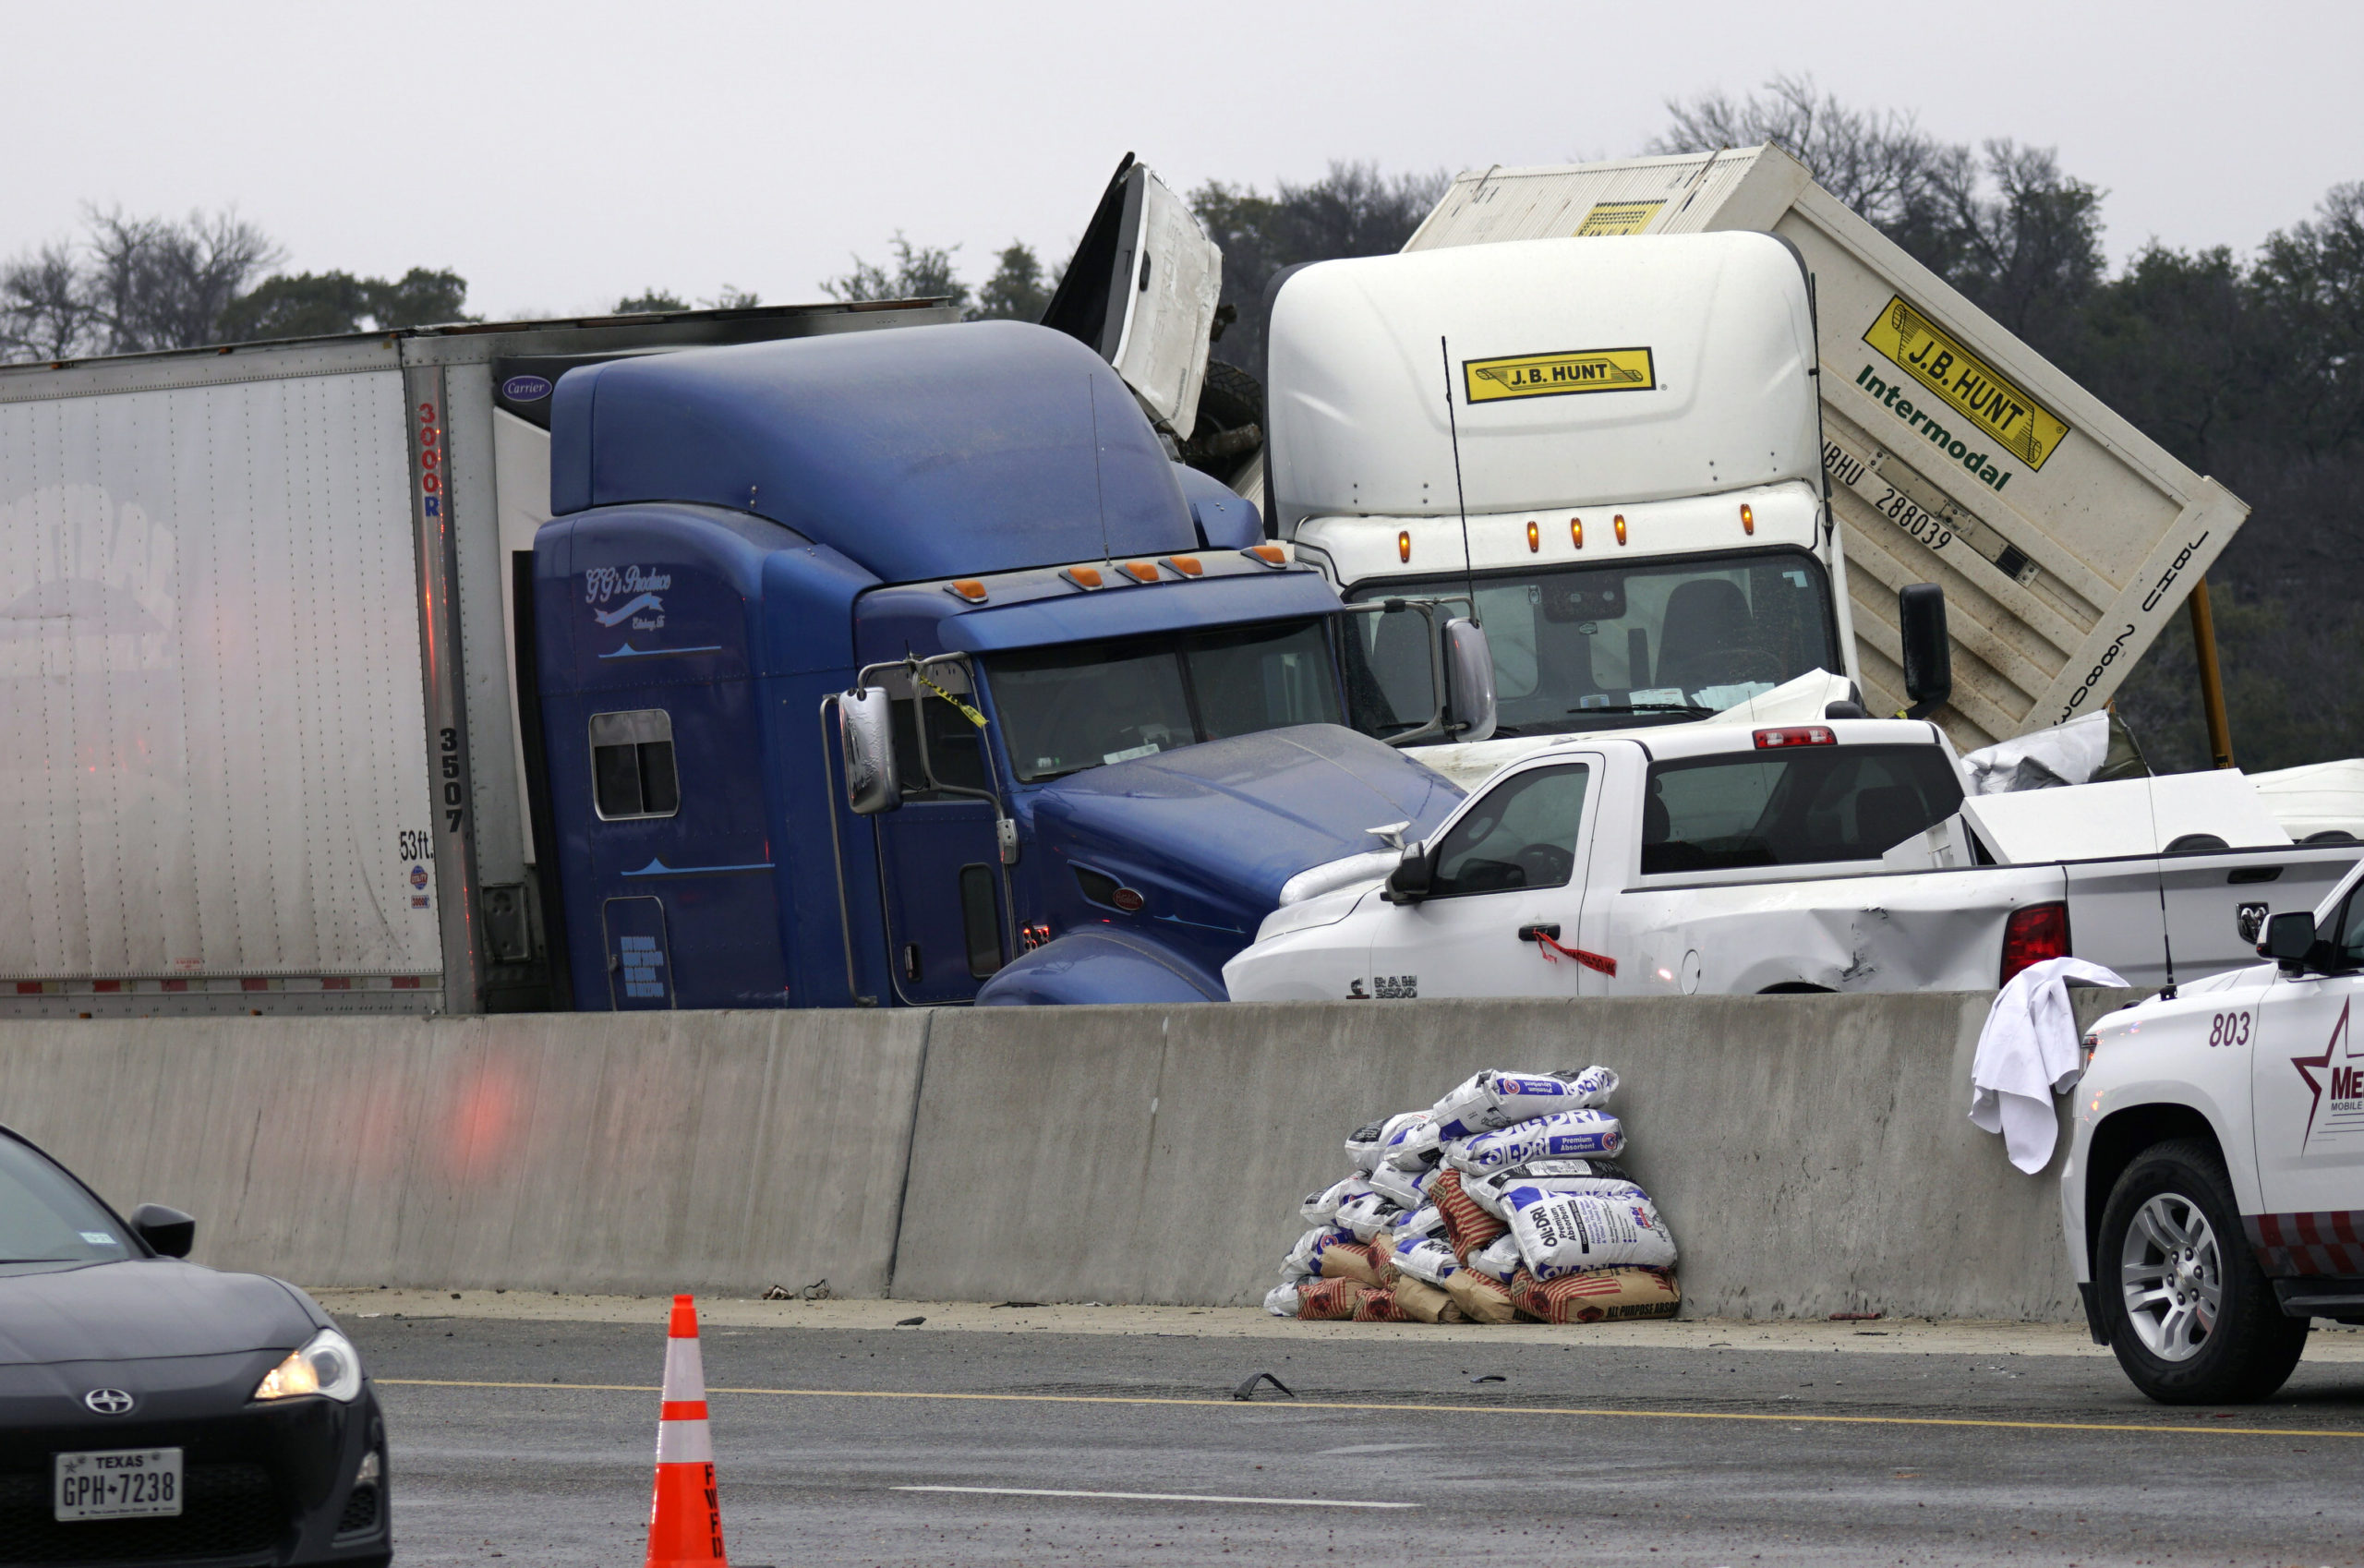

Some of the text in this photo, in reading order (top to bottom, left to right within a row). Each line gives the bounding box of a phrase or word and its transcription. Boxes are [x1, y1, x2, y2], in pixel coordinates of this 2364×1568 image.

[507, 381, 546, 395] Carrier
[1511, 364, 1608, 386] J.B. HUNT
[1908, 341, 2026, 432] J.B. HUNT
[1855, 364, 2013, 492] Intermodal
[418, 403, 440, 517] 3000R
[1875, 488, 1953, 550] 288039
[2141, 530, 2210, 612] JBHU
[440, 728, 463, 833] 3507
[400, 830, 435, 861] 53ft.
[1374, 975, 1417, 988] RAM
[1375, 987, 1418, 999] 3500
[2209, 1011, 2250, 1047] 803
[2331, 1067, 2364, 1100] ME
[2331, 1101, 2363, 1111] MOBILE
[1560, 1142, 1596, 1152] Absorbent
[1550, 1207, 1567, 1239] Premium
[1560, 1204, 1577, 1241] Absorbent
[1607, 1307, 1620, 1320] ALL
[1620, 1304, 1654, 1317] PURPOSE
[96, 1455, 144, 1469] TEXAS
